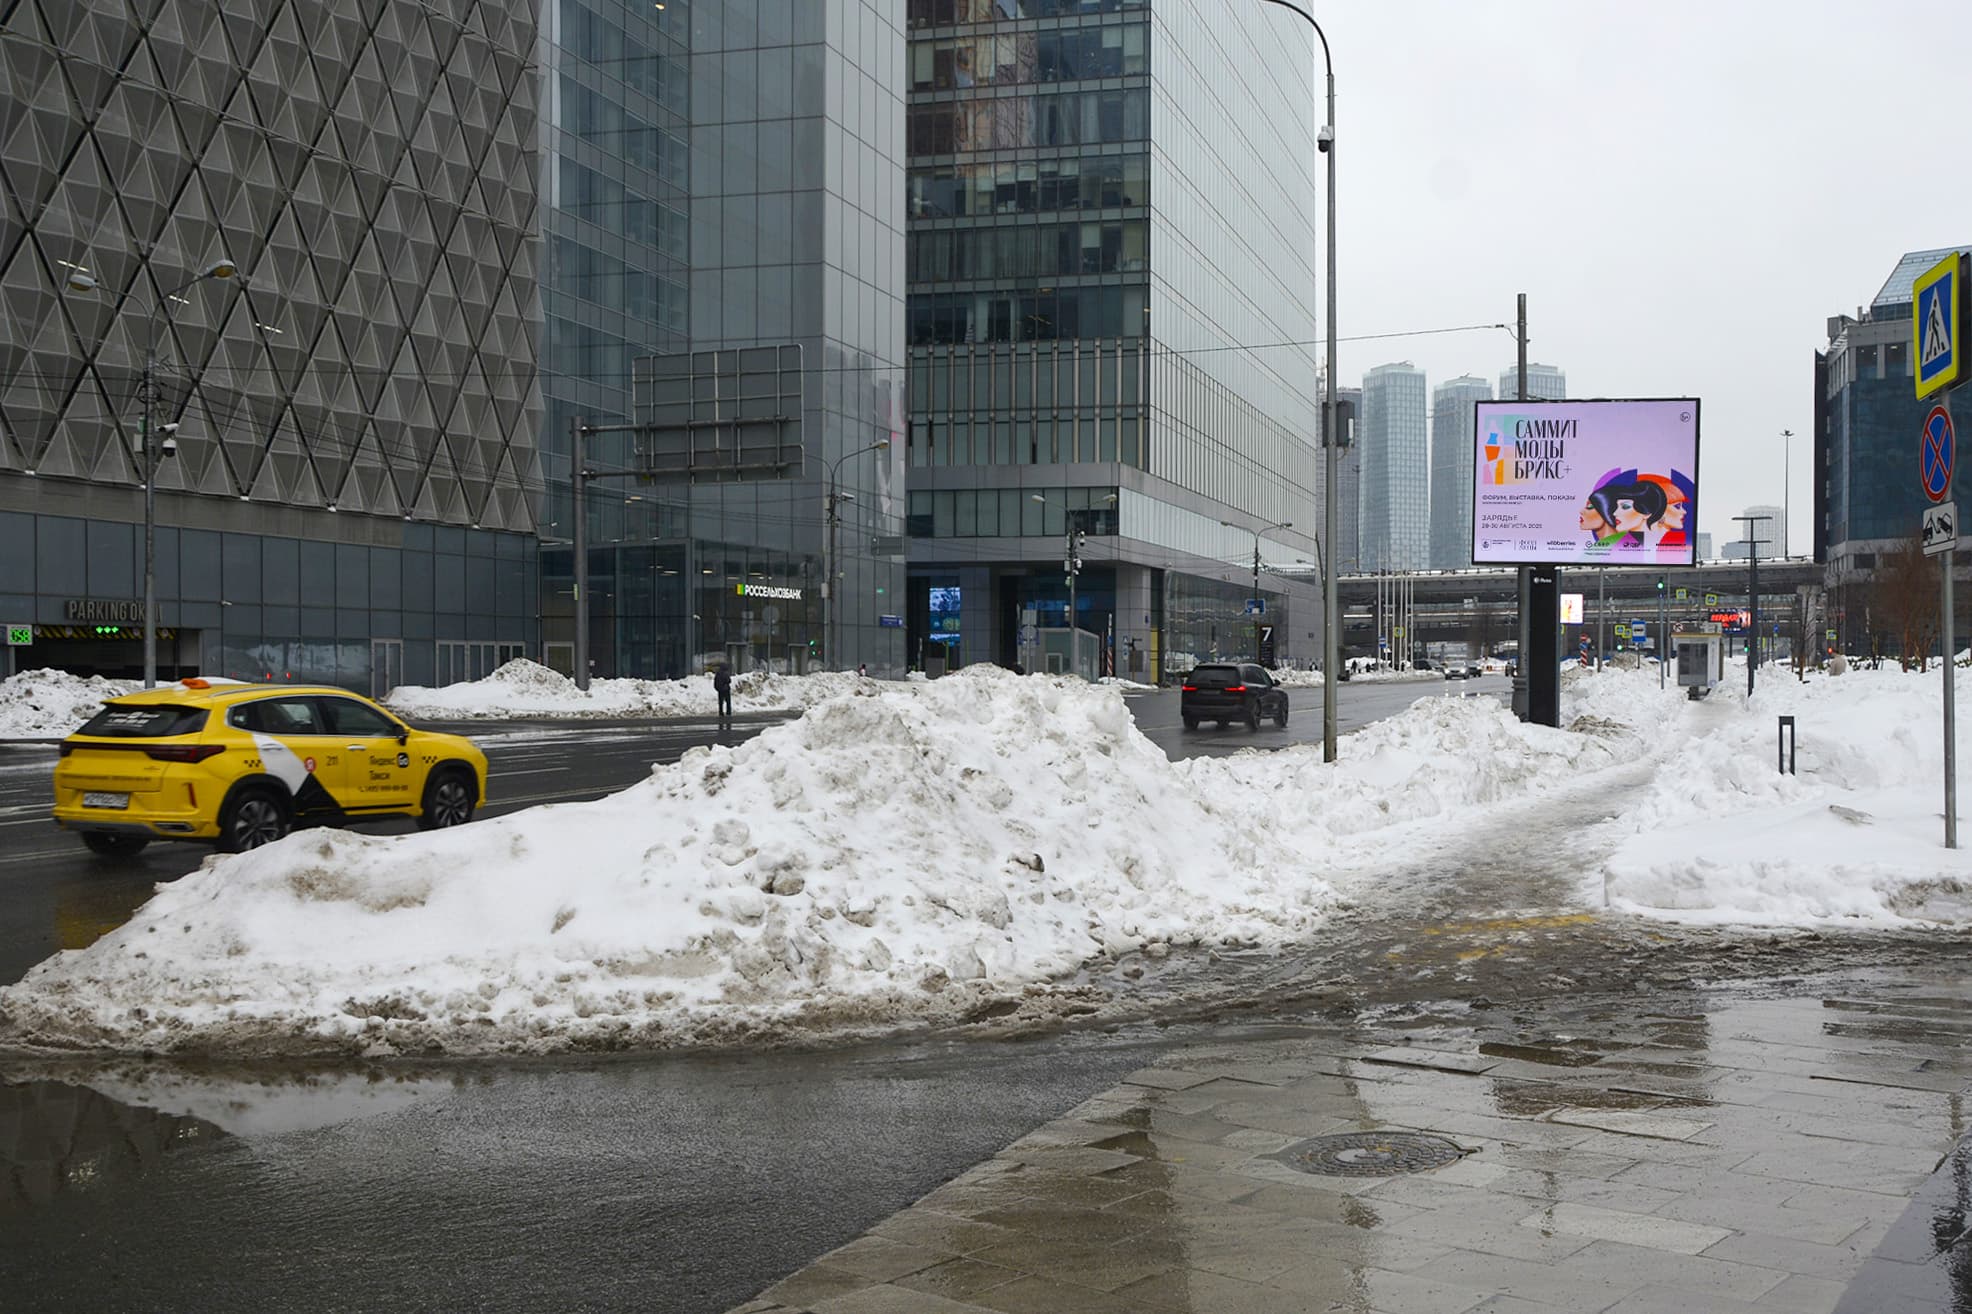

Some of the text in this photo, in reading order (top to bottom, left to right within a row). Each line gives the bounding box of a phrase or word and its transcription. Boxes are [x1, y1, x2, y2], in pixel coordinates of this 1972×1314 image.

[1515, 419, 1579, 439] САММИТ
[1514, 440, 1564, 460] МОДЫ
[1514, 460, 1572, 480] БРИКС+
[745, 584, 802, 600] РОССЕЛЬХОЗБАНК
[68, 600, 127, 621] PARKING
[1261, 626, 1273, 641] 7
